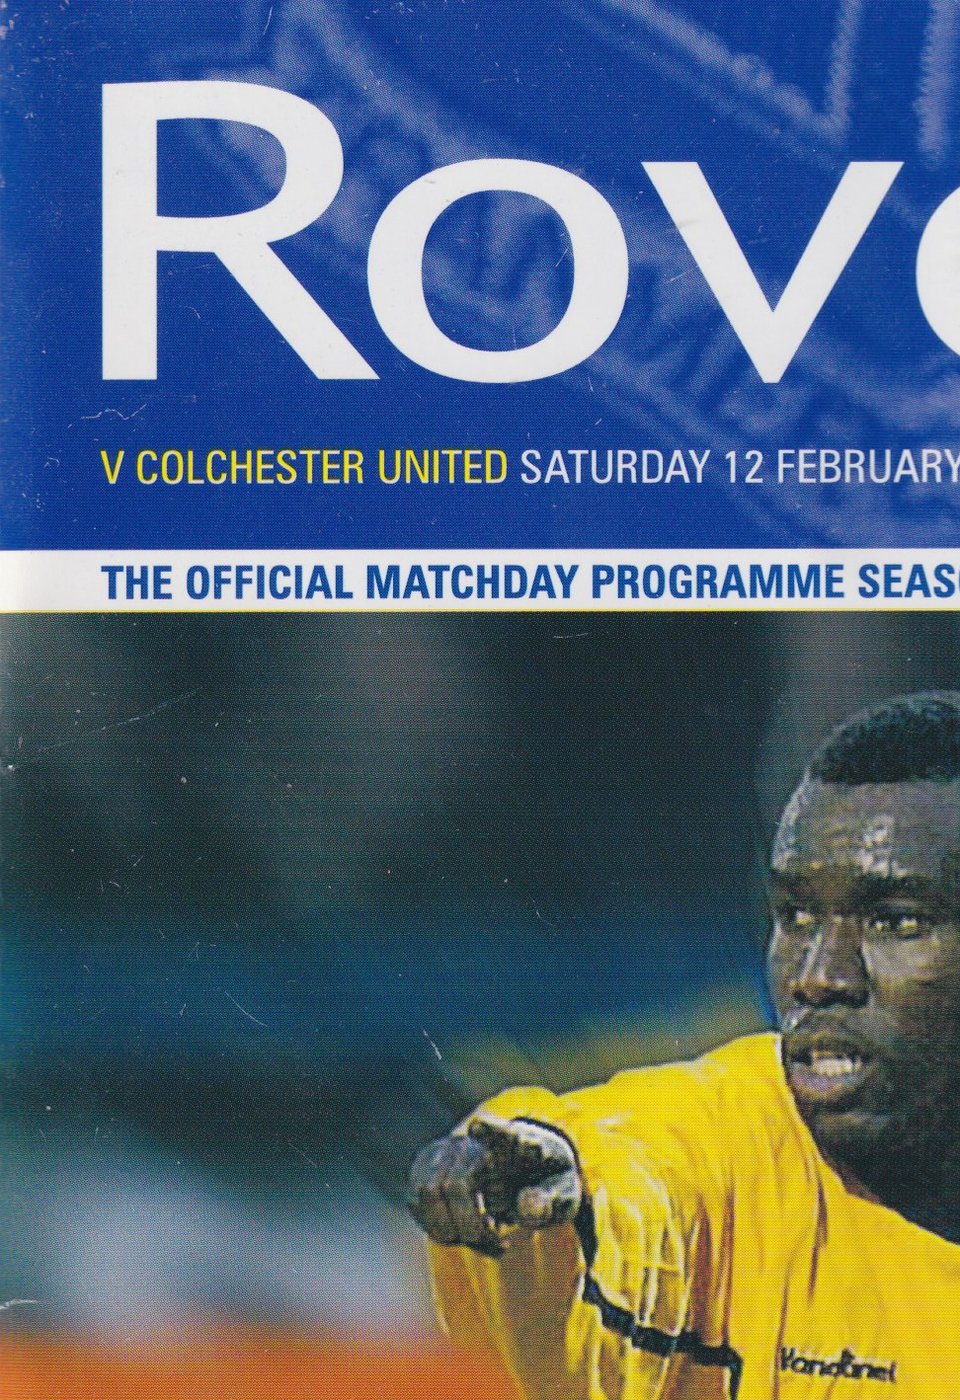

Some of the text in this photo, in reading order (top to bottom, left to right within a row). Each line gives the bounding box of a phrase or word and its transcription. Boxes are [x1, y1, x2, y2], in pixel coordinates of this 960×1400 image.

[101, 450, 125, 484] V
[137, 450, 364, 485] COLCHESTER
[379, 450, 507, 484] UNITED
[521, 450, 711, 484] SATURDAY
[725, 450, 763, 484] 12
[101, 565, 173, 600] THE
[186, 564, 354, 600] OFFICIAL
[366, 564, 579, 600] MATCHDAY
[592, 564, 845, 599] PROGRAMME
